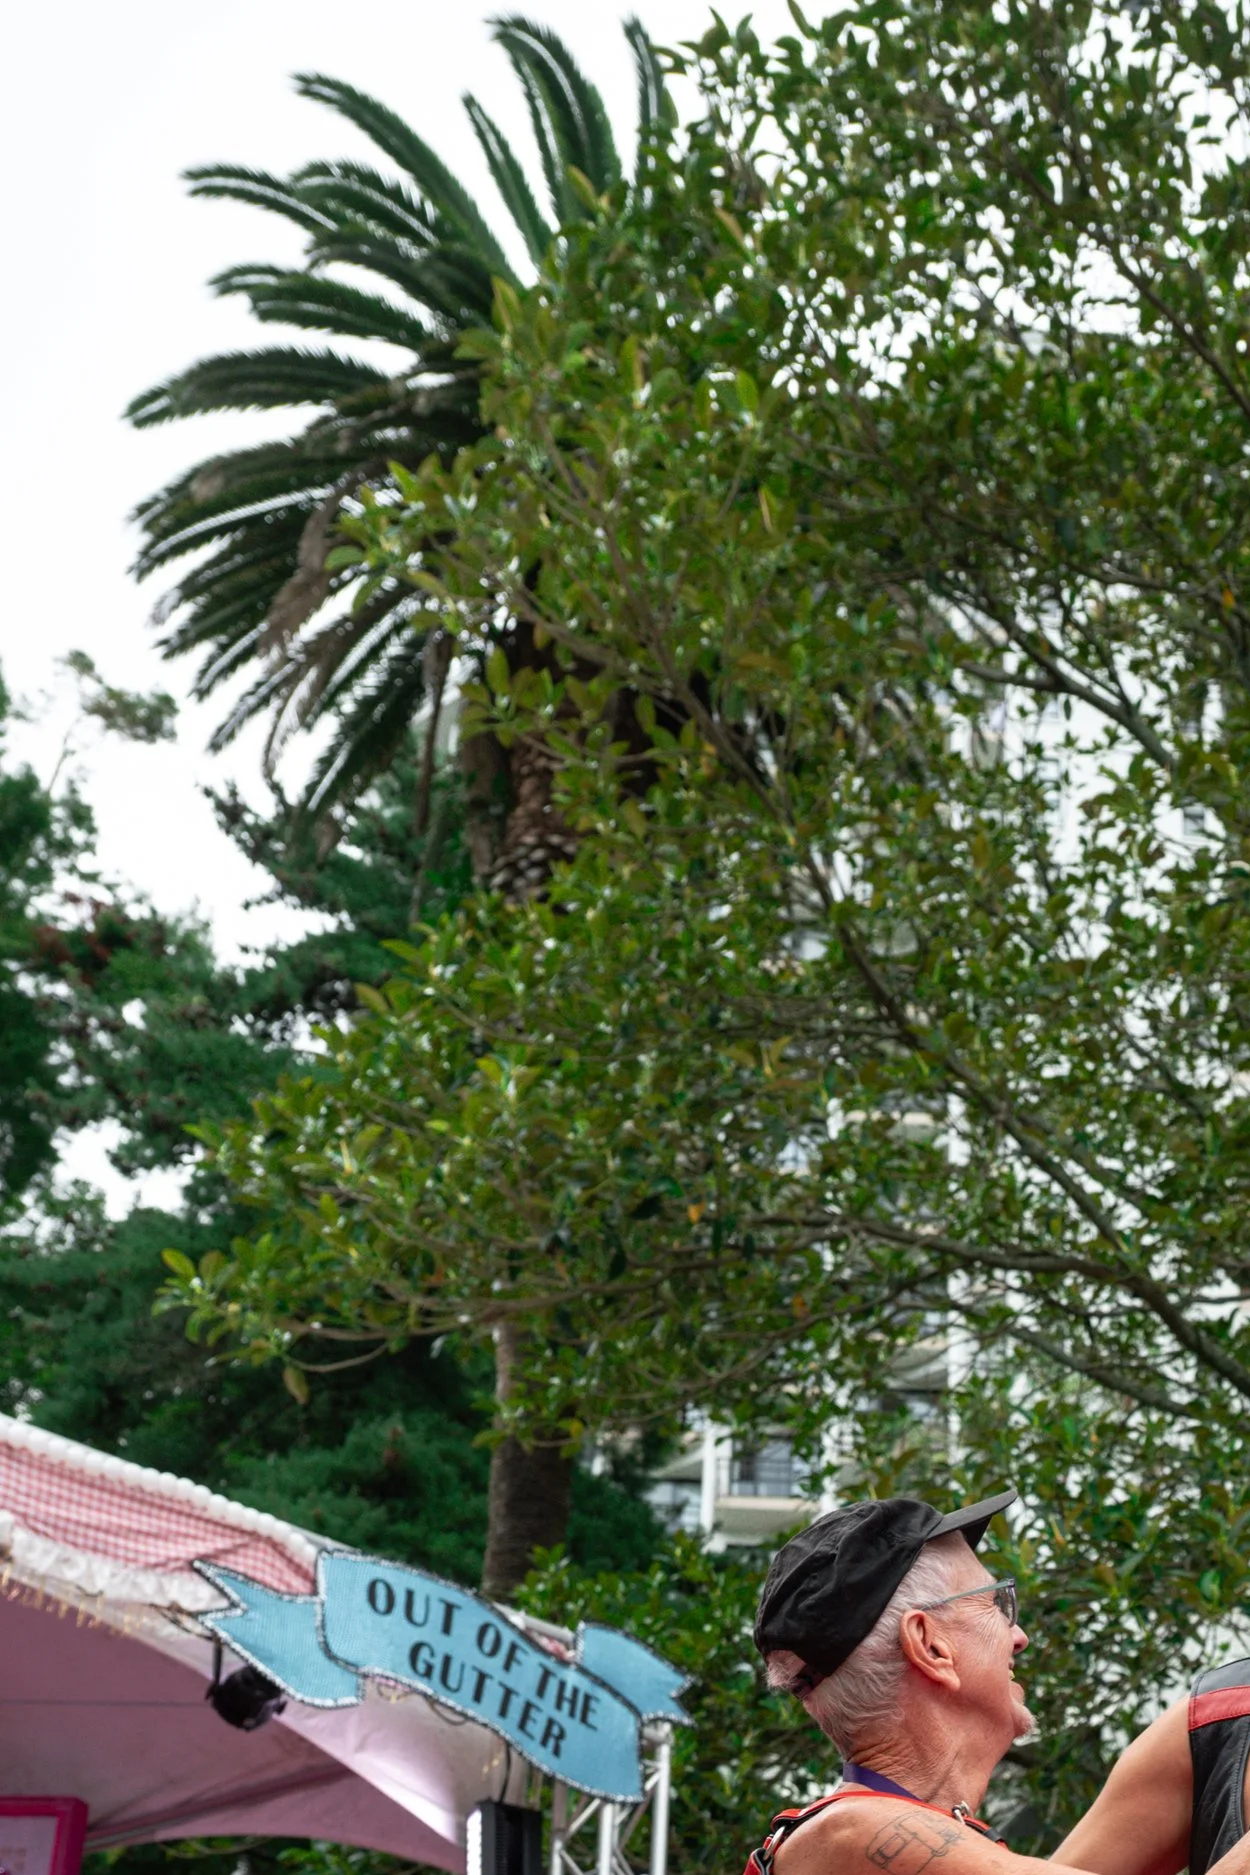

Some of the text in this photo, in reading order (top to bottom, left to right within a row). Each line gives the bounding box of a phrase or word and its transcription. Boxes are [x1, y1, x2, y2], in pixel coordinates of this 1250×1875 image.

[367, 1577, 600, 1732] OUT OF THE
[408, 1640, 567, 1758] GUTTER
